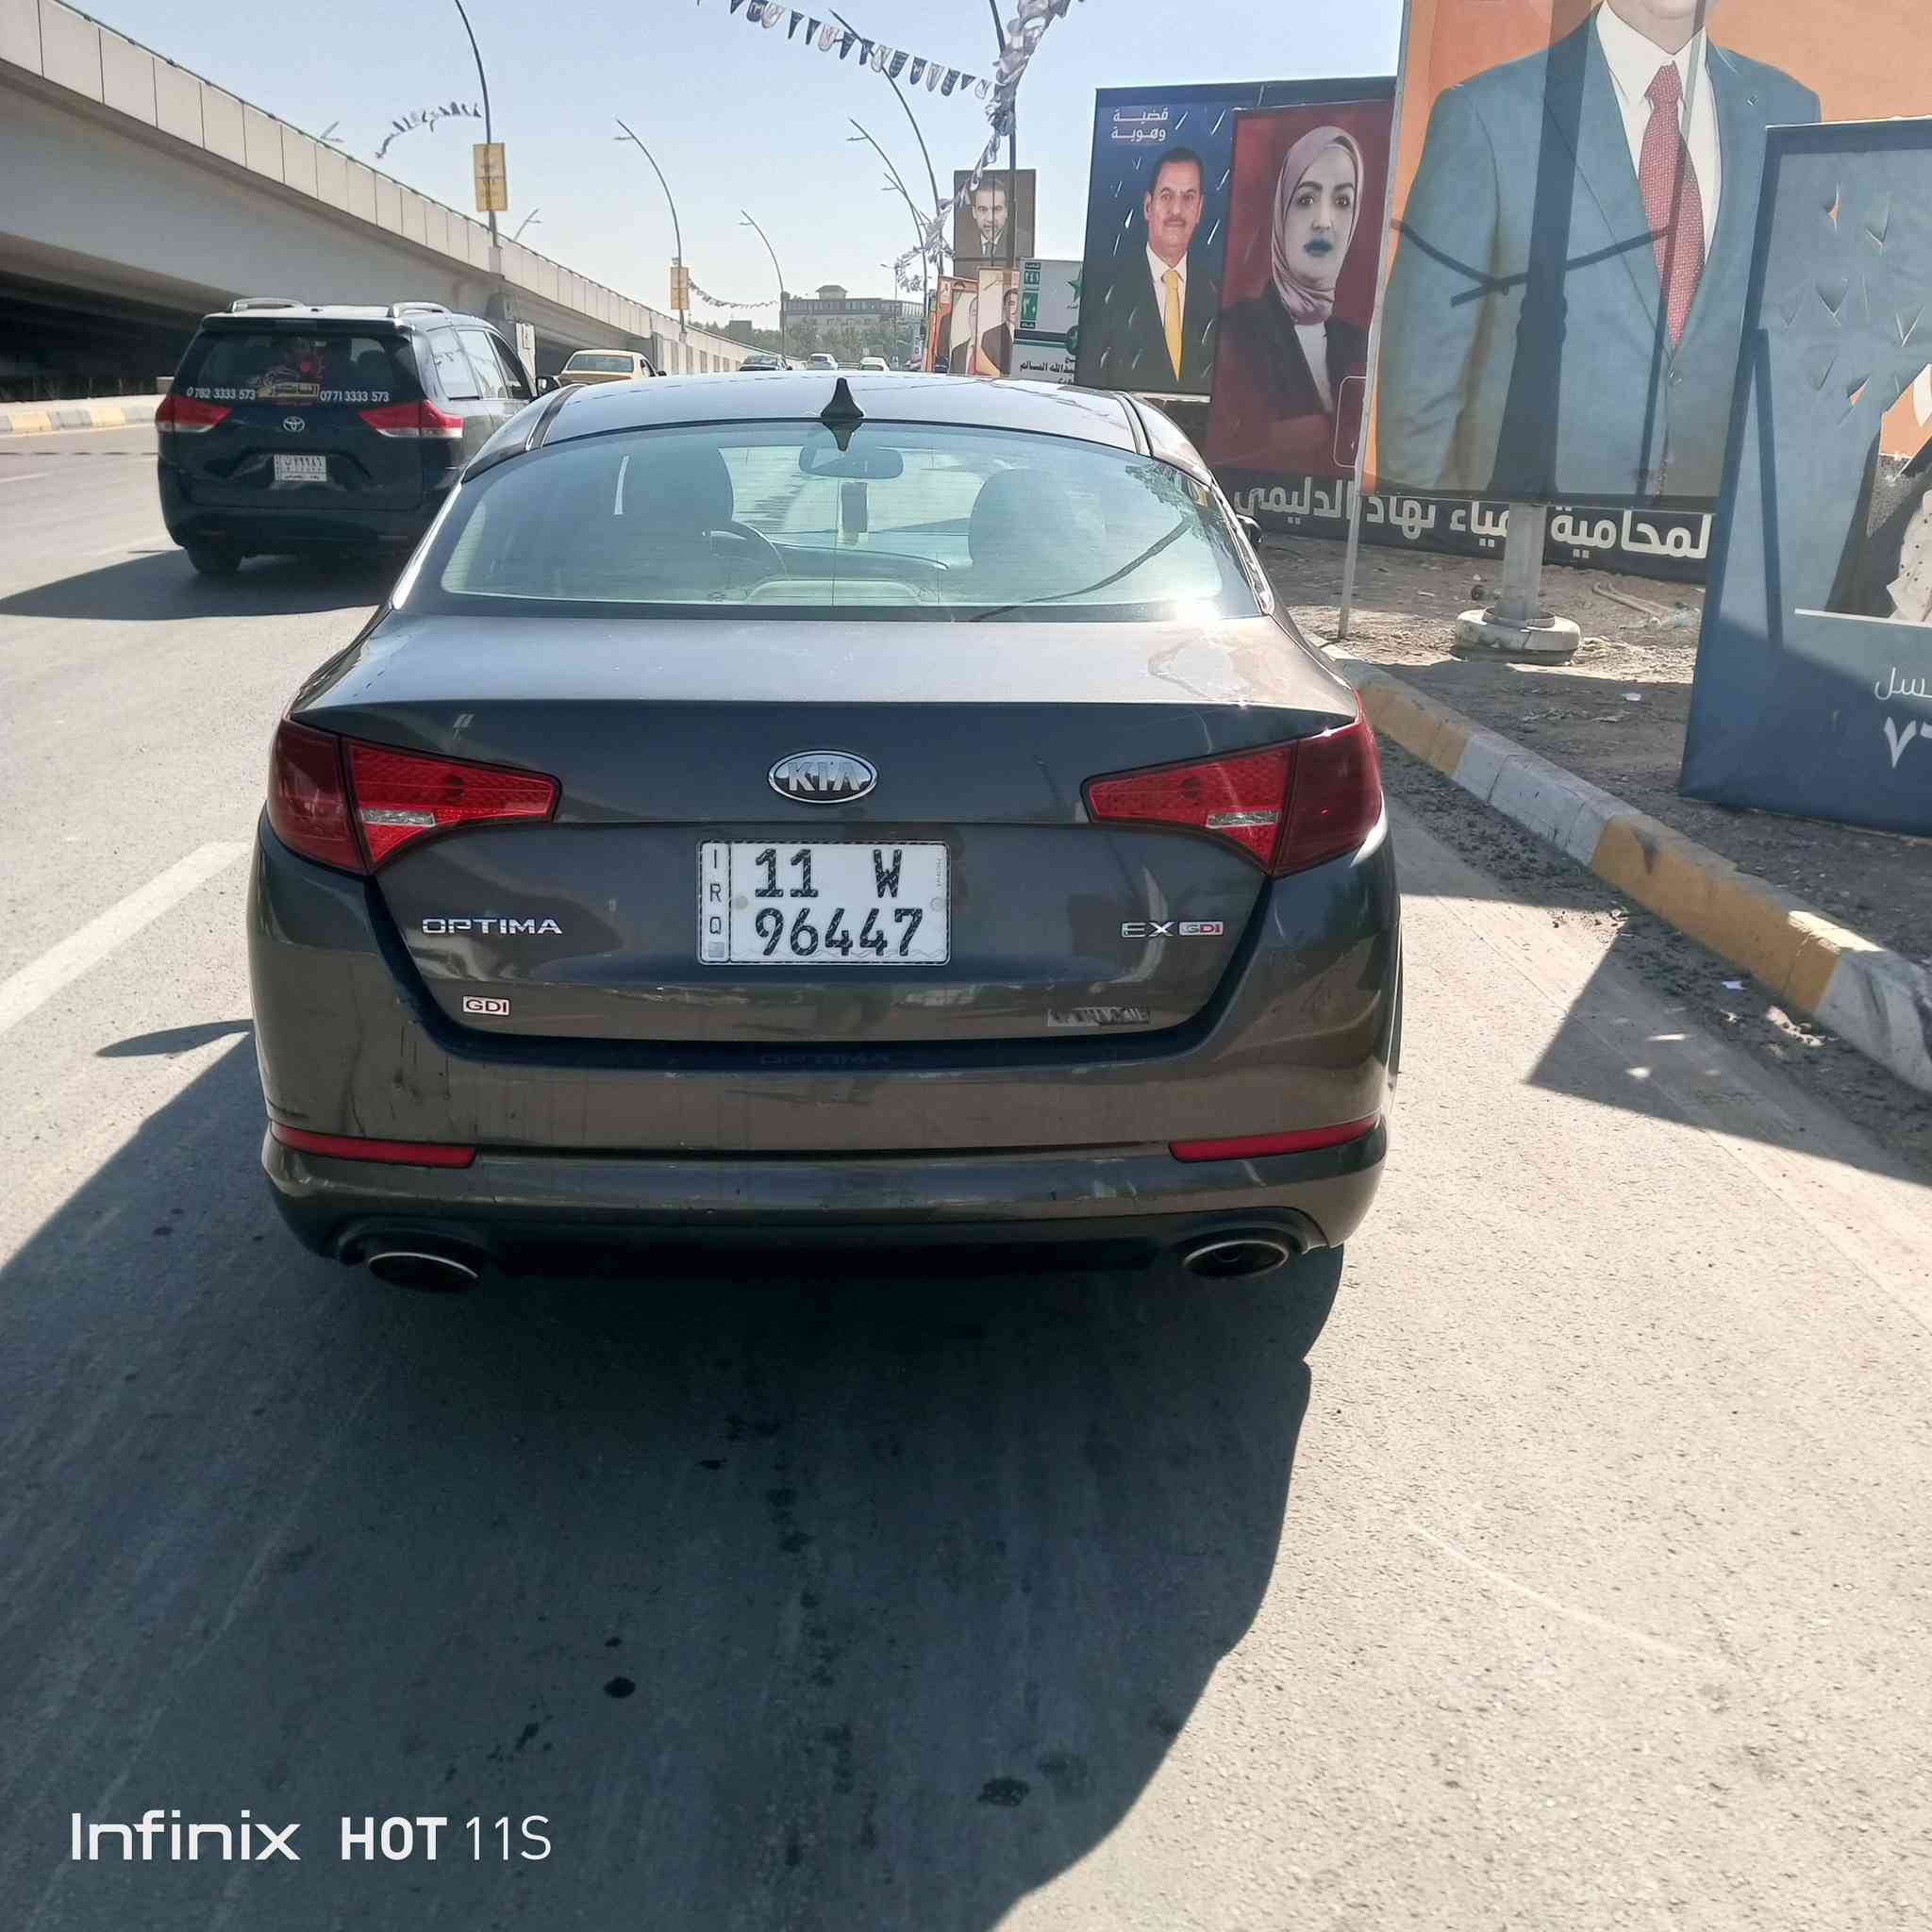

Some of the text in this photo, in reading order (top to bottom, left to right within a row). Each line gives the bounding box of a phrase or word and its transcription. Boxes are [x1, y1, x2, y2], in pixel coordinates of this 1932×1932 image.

[1113, 107, 1169, 125] قضية
[1550, 505, 1713, 559] لمحامية
[787, 760, 861, 792] KIA
[755, 848, 819, 898] 11
[873, 848, 903, 898] W
[422, 918, 563, 935] OPTIMA
[755, 907, 924, 957] 96447
[1121, 921, 1223, 938] EX GDI
[465, 998, 508, 1014] GDI
